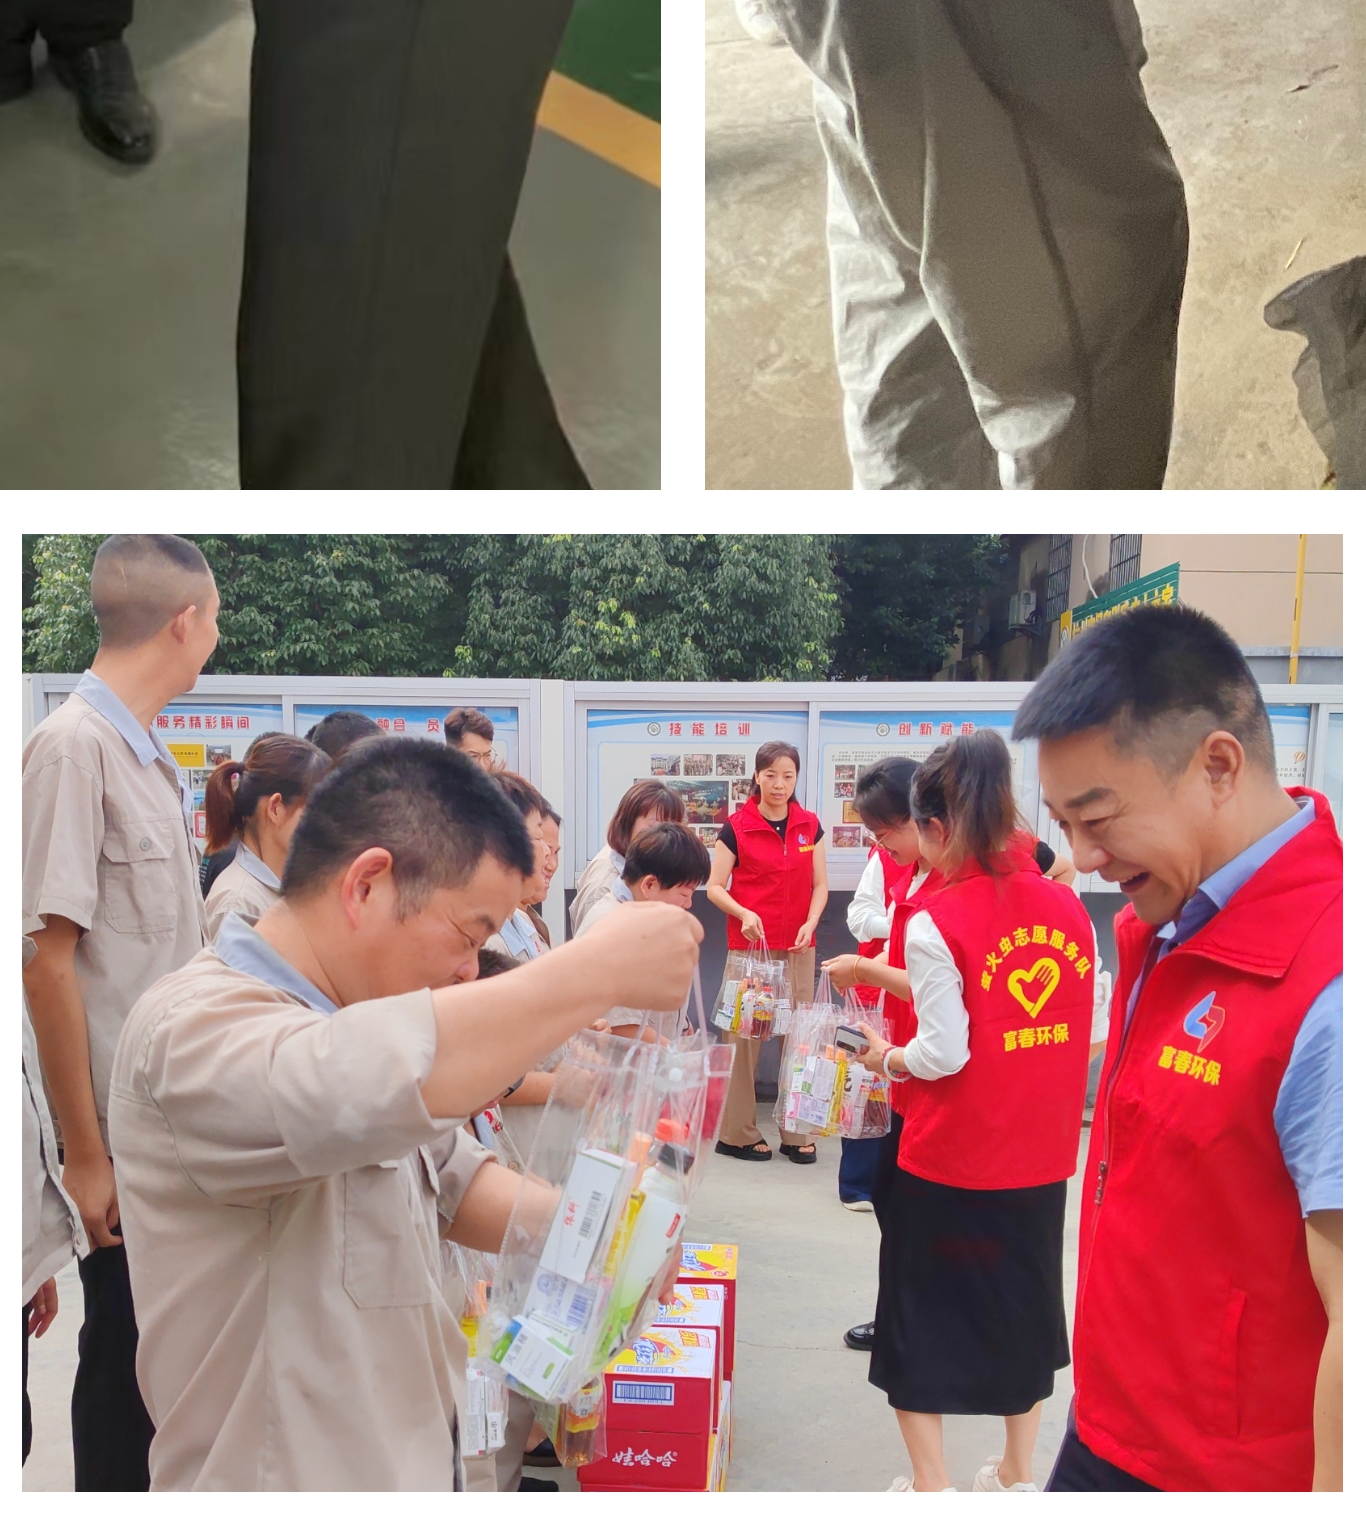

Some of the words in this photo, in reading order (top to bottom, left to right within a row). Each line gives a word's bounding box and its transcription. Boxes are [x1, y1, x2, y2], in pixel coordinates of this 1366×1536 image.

[151, 715, 250, 730] 服务精彩瞬间
[668, 722, 750, 736] 技能培训
[898, 722, 975, 736] 创新赋能
[981, 925, 1092, 992] 萤火虫志愿服务队
[1003, 1023, 1070, 1052] 富春环保
[1158, 1046, 1222, 1086] 富春环保
[612, 1446, 677, 1468] 娃哈哈
